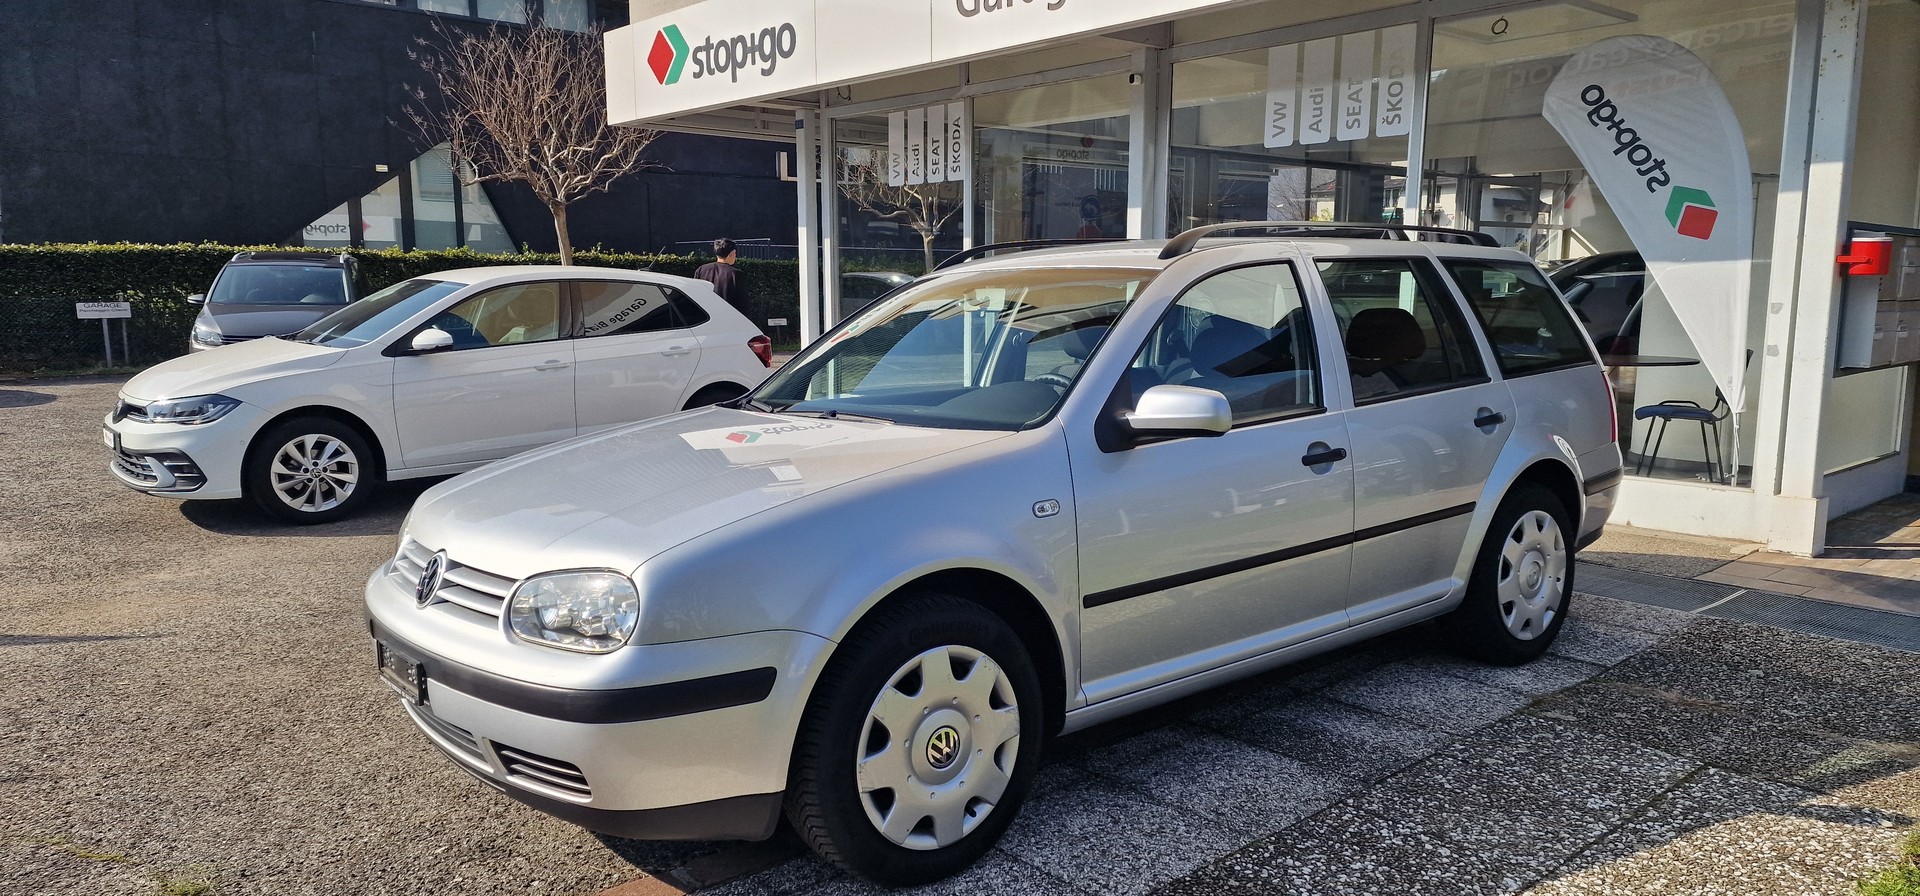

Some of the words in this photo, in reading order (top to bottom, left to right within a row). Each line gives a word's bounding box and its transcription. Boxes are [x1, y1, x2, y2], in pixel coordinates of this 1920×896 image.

[692, 22, 797, 83] stop+go
[1272, 101, 1287, 139] VW
[1308, 86, 1324, 134] Audi
[1345, 77, 1363, 130] SEAT
[892, 152, 901, 180] VW
[911, 143, 920, 178] Audi
[931, 137, 940, 176] SEAT
[950, 116, 961, 174] ŠKODA
